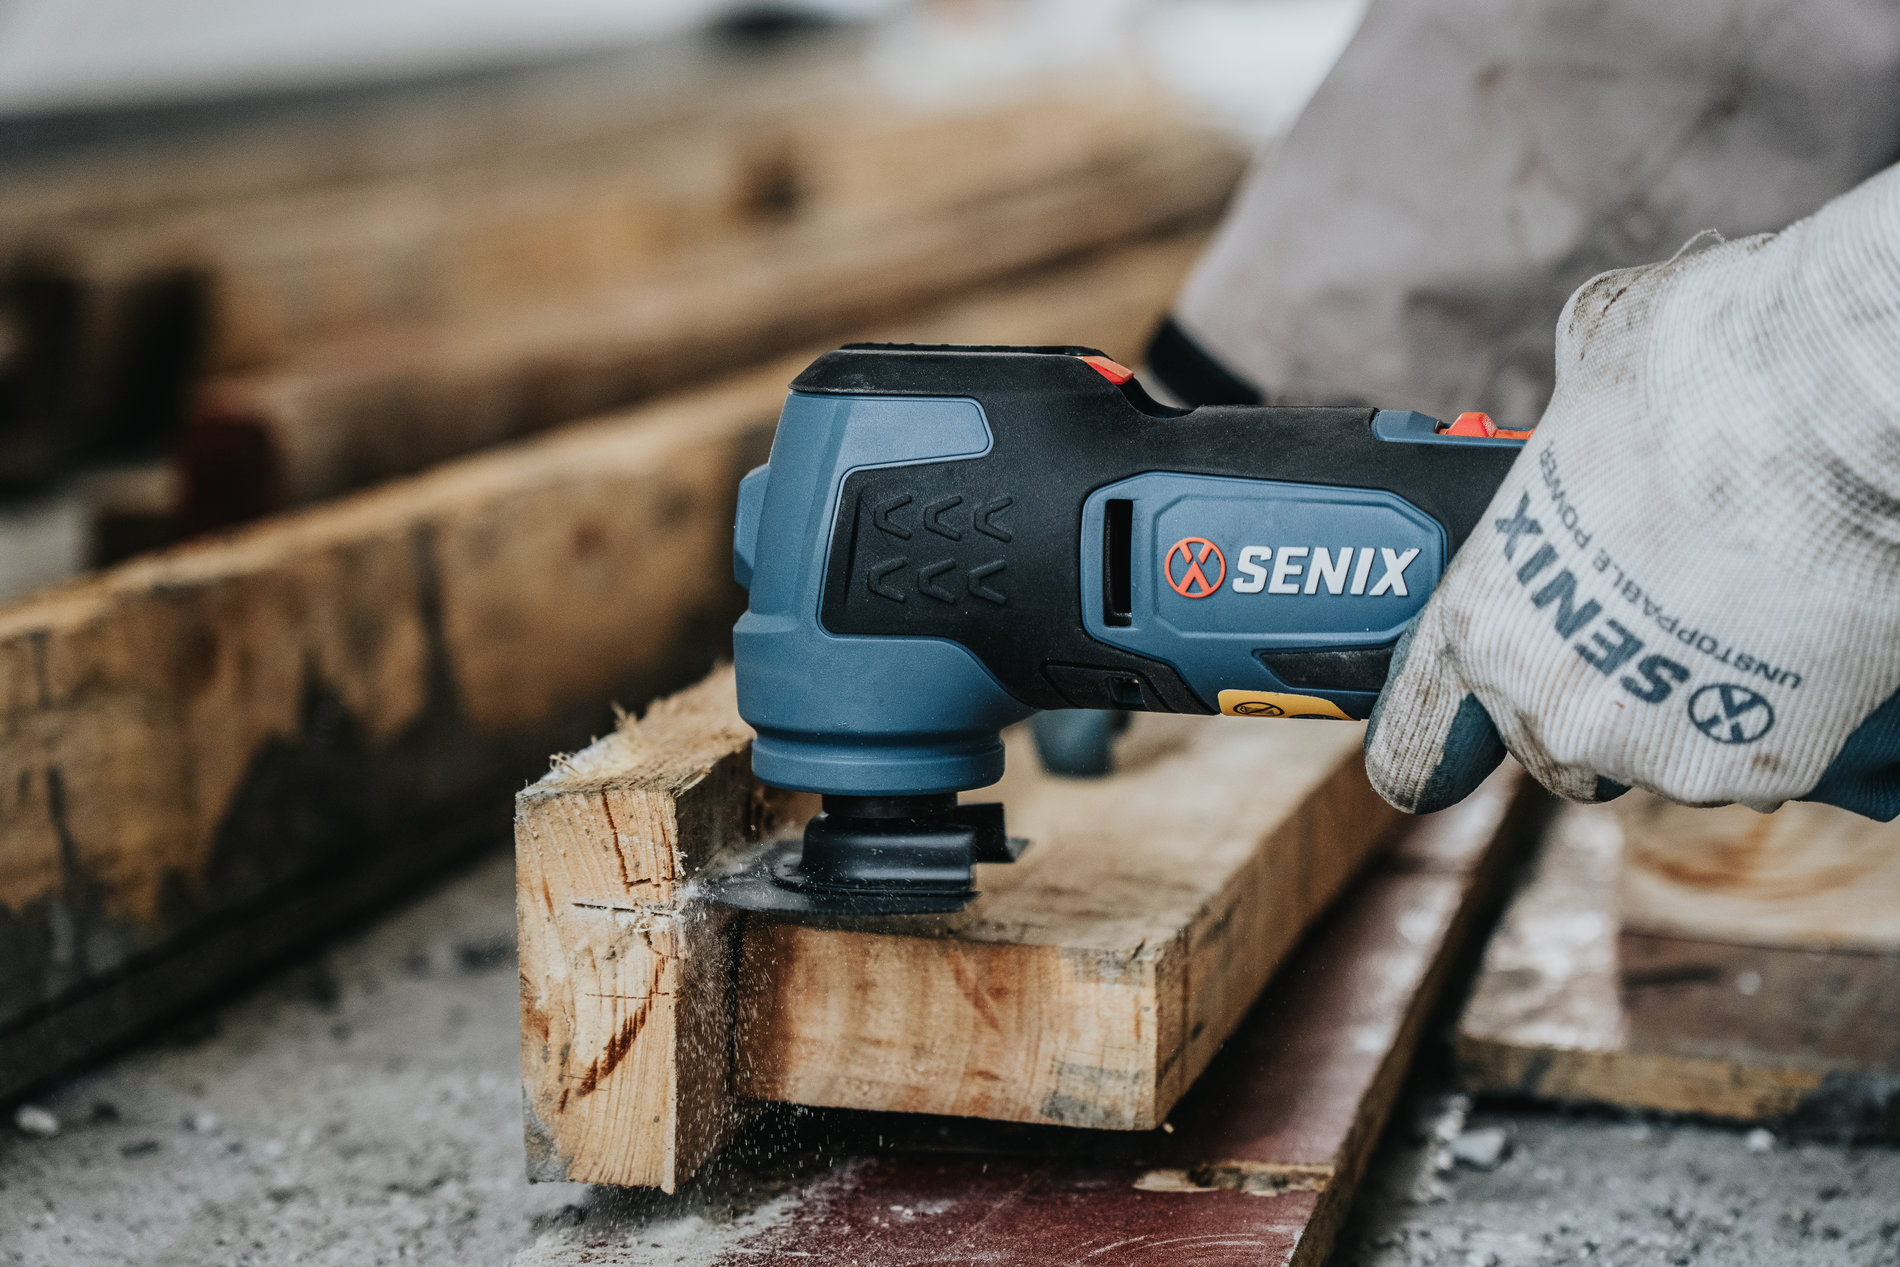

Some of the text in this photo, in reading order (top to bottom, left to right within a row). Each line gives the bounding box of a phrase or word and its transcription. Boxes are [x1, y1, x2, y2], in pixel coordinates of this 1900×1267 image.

[1232, 545, 1421, 597] SENIX
[1494, 490, 1691, 704] SENIX
[1592, 548, 1803, 690] UNSTOPPABLE
